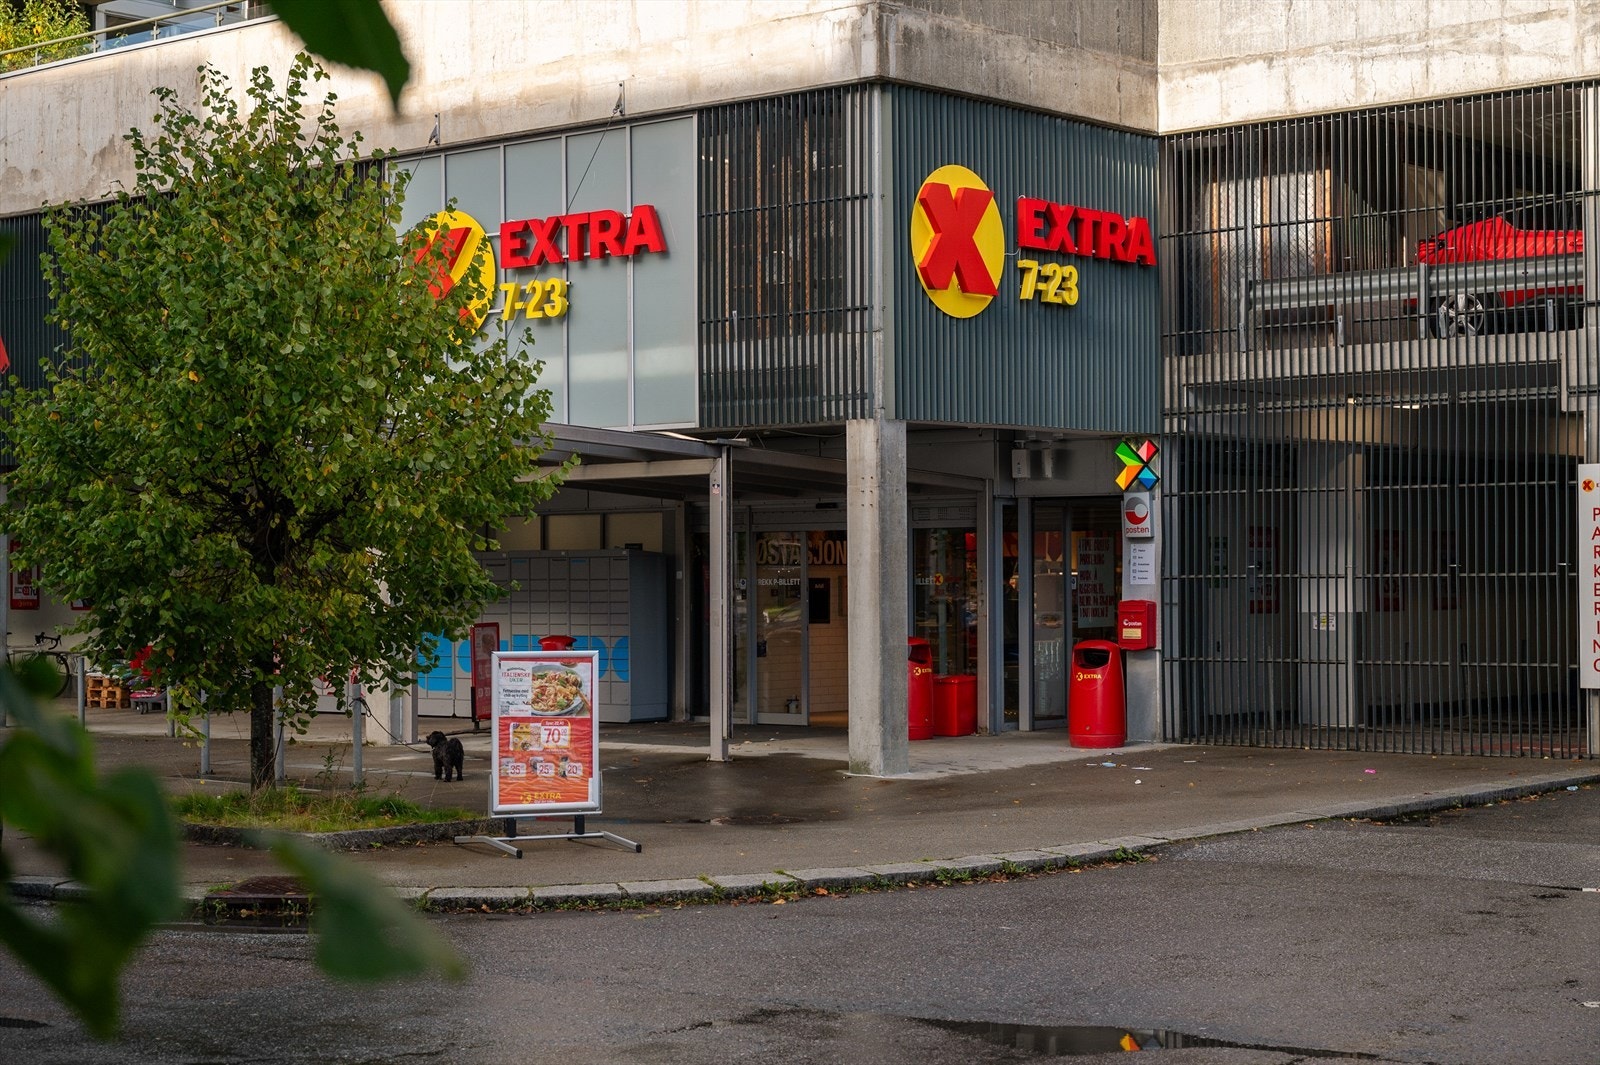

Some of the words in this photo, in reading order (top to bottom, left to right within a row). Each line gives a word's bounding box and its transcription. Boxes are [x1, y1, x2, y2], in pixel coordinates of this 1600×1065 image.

[499, 204, 667, 269] EXTRA
[1017, 198, 1157, 266] EXTRA
[1017, 259, 1079, 306] 7-23
[499, 277, 570, 321] 7-23
[1126, 526, 1149, 534] posten
[773, 578, 800, 586] P-BILLETT
[544, 728, 561, 744] 70
[510, 765, 521, 775] 35
[534, 792, 561, 800] EXTRA
